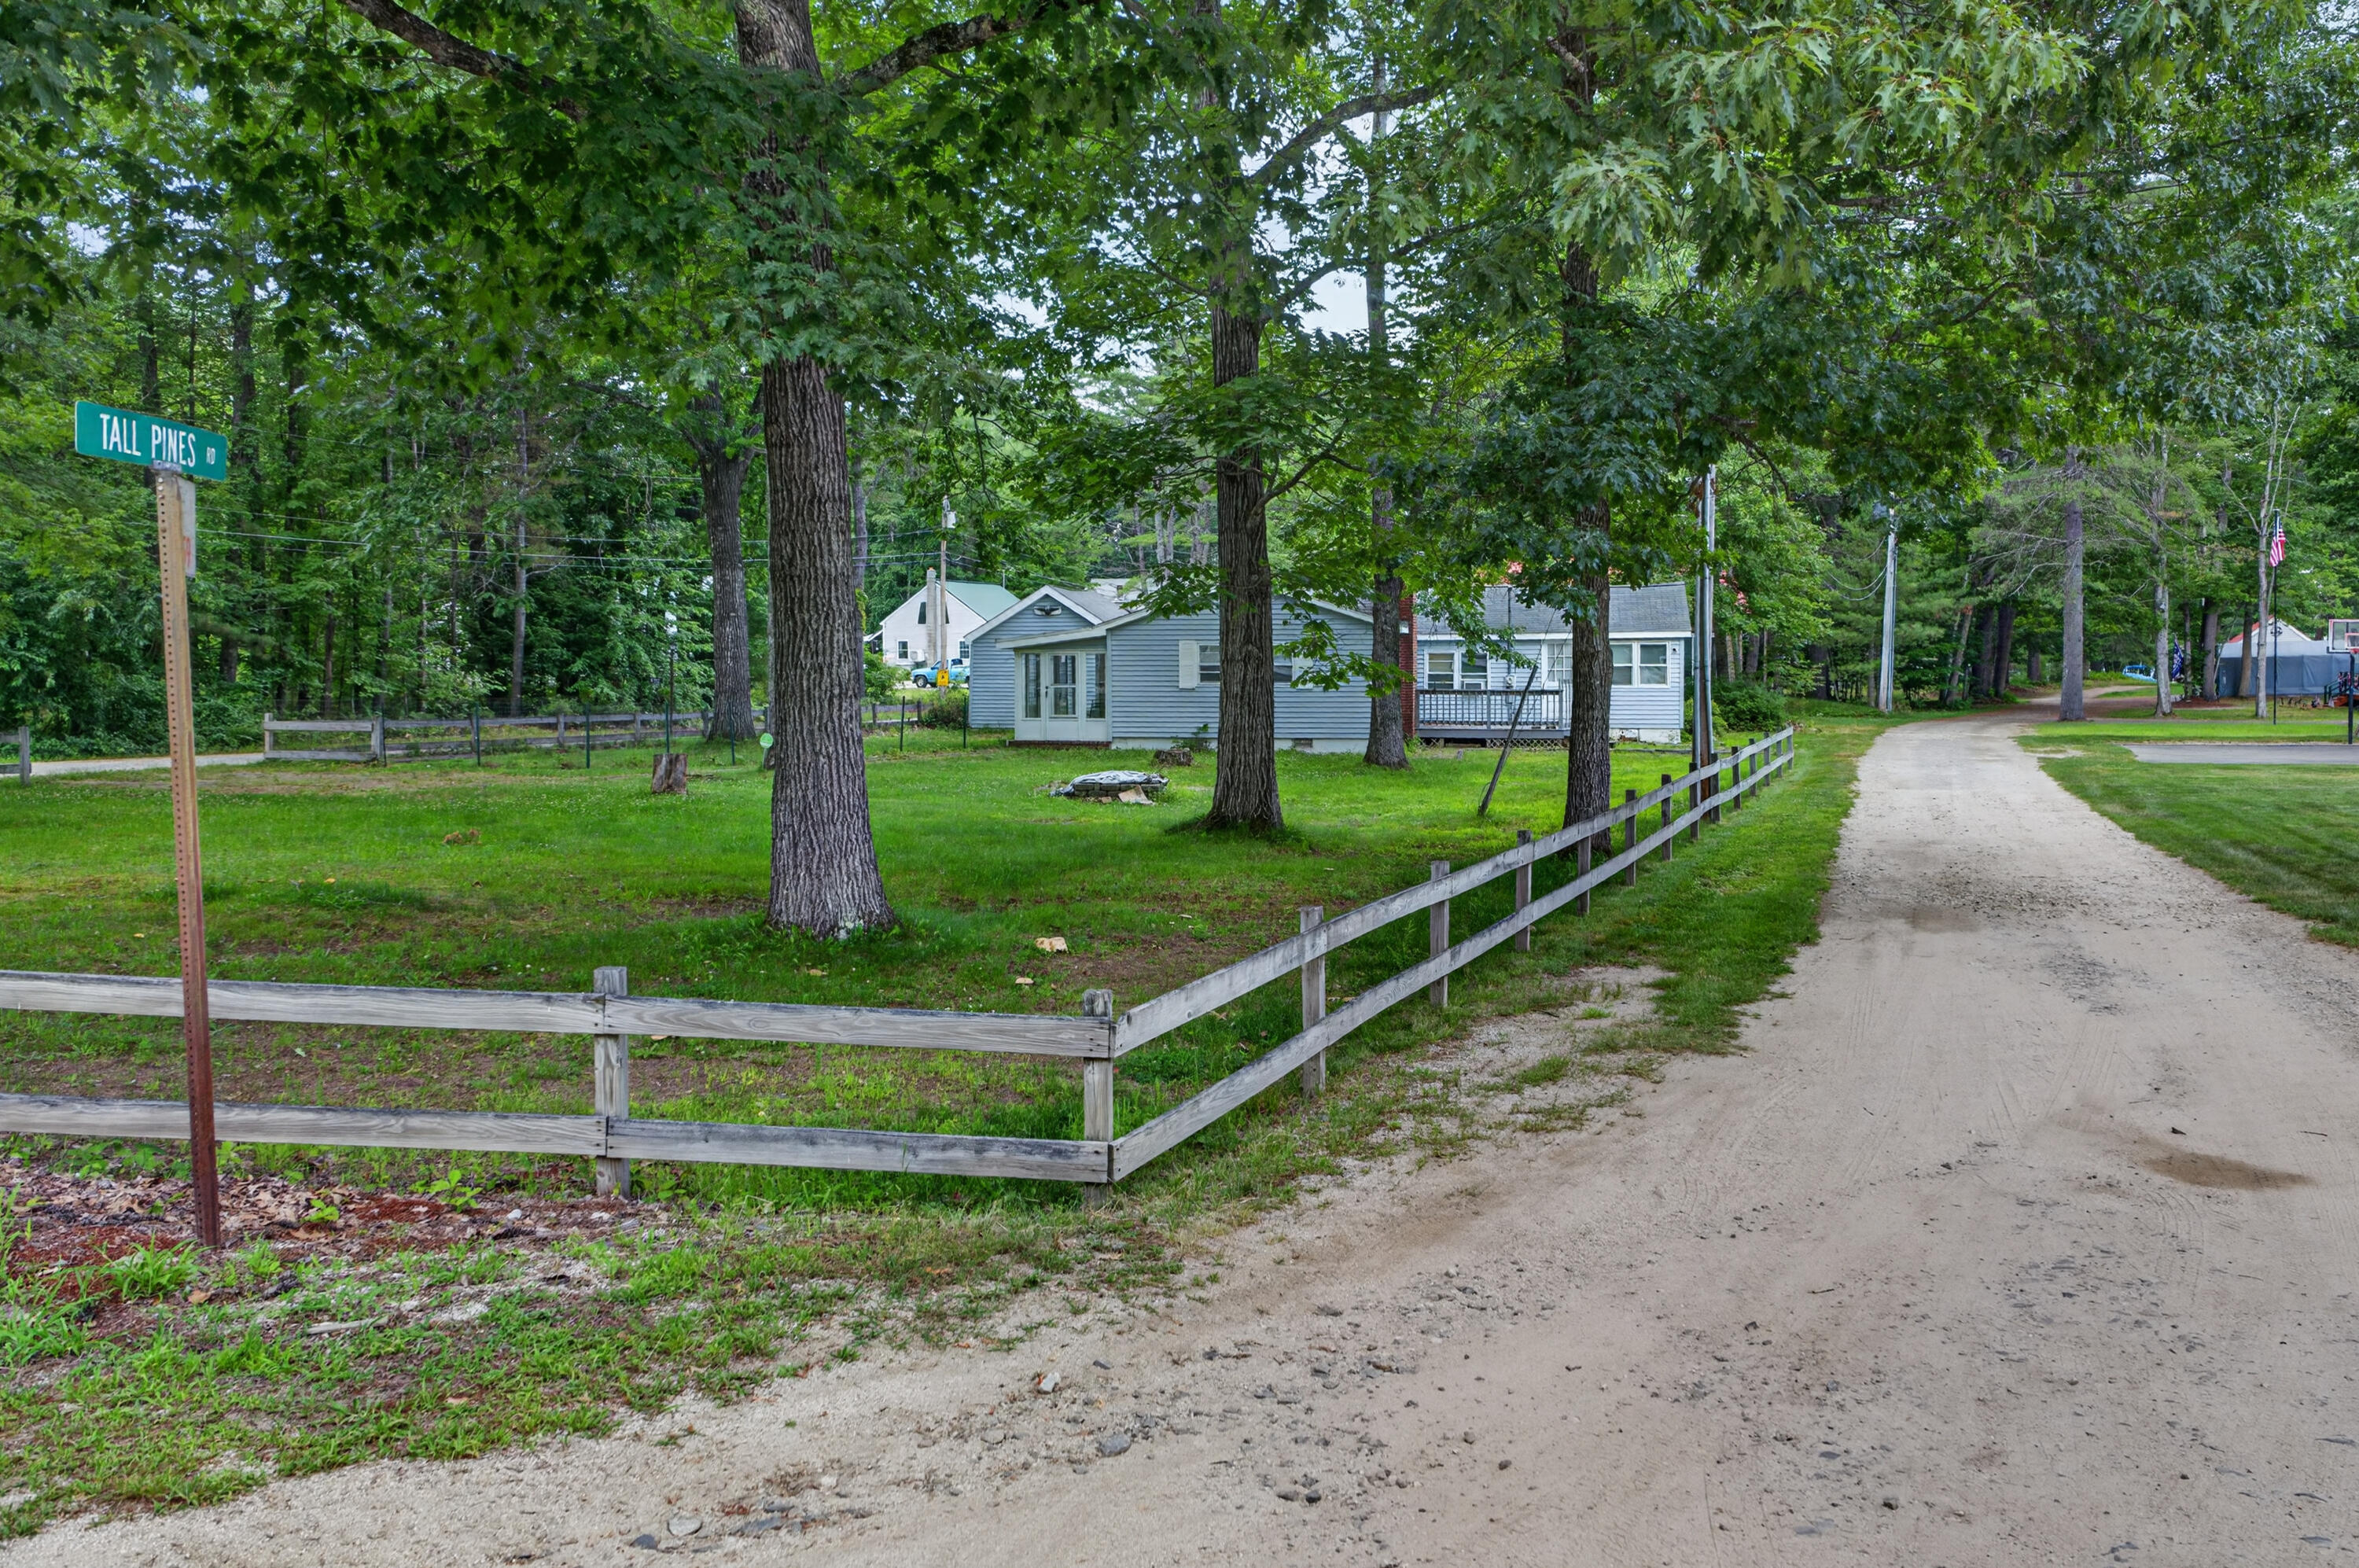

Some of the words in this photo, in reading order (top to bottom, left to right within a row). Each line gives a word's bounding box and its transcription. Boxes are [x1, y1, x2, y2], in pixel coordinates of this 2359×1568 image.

[99, 413, 142, 456] TALL
[151, 424, 196, 467] PINES
[206, 446, 216, 465] RD
